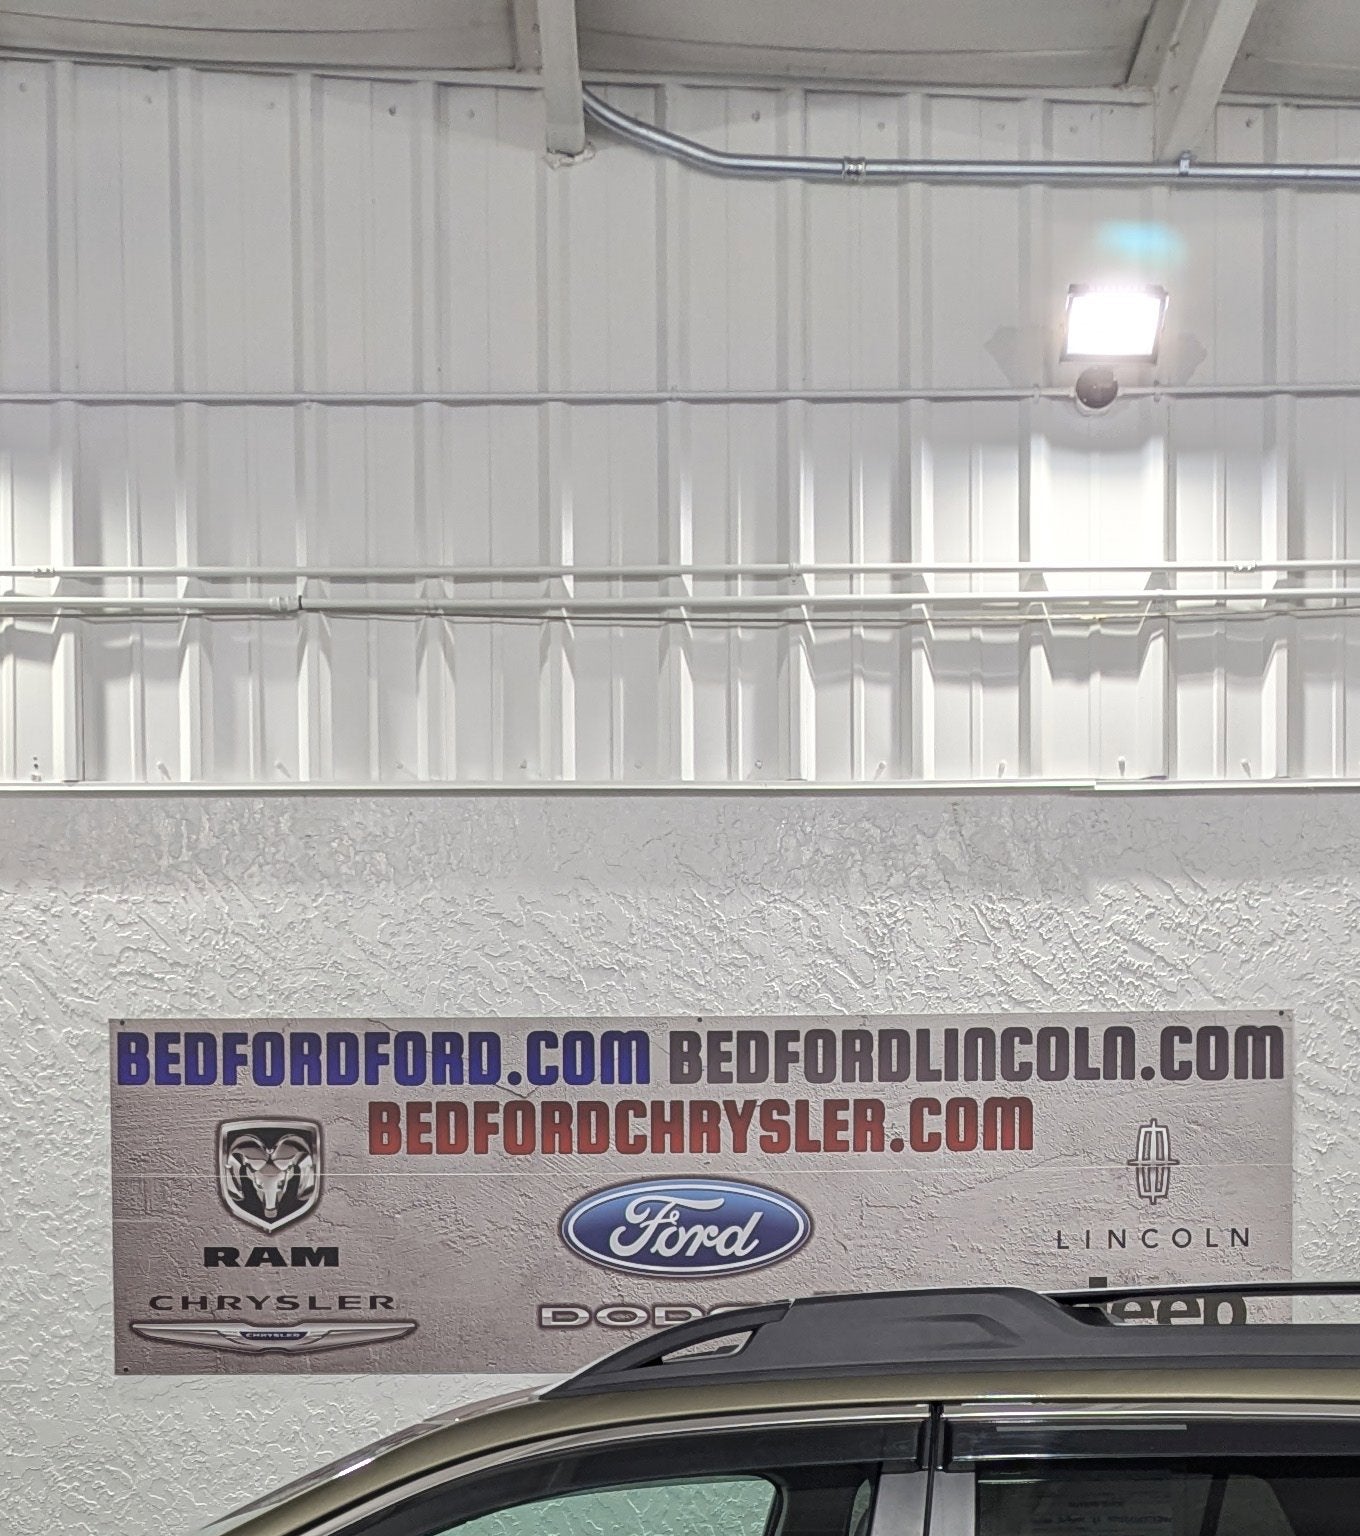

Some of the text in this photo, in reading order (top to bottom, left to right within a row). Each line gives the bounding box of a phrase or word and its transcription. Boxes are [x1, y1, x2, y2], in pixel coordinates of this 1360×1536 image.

[117, 1025, 1285, 1087] BEDFORDFORD.COM BEDFORDLINCOLN.COM
[368, 1096, 1034, 1156] BEDFORDCHRYSLER.COM
[609, 1195, 764, 1257] Ford
[1056, 1227, 1250, 1250] LINCOLN
[203, 1246, 339, 1268] RAM
[148, 1295, 395, 1311] CHRYSLER
[541, 1306, 750, 1326] DOD
[245, 1332, 301, 1340] CHRYSLER
